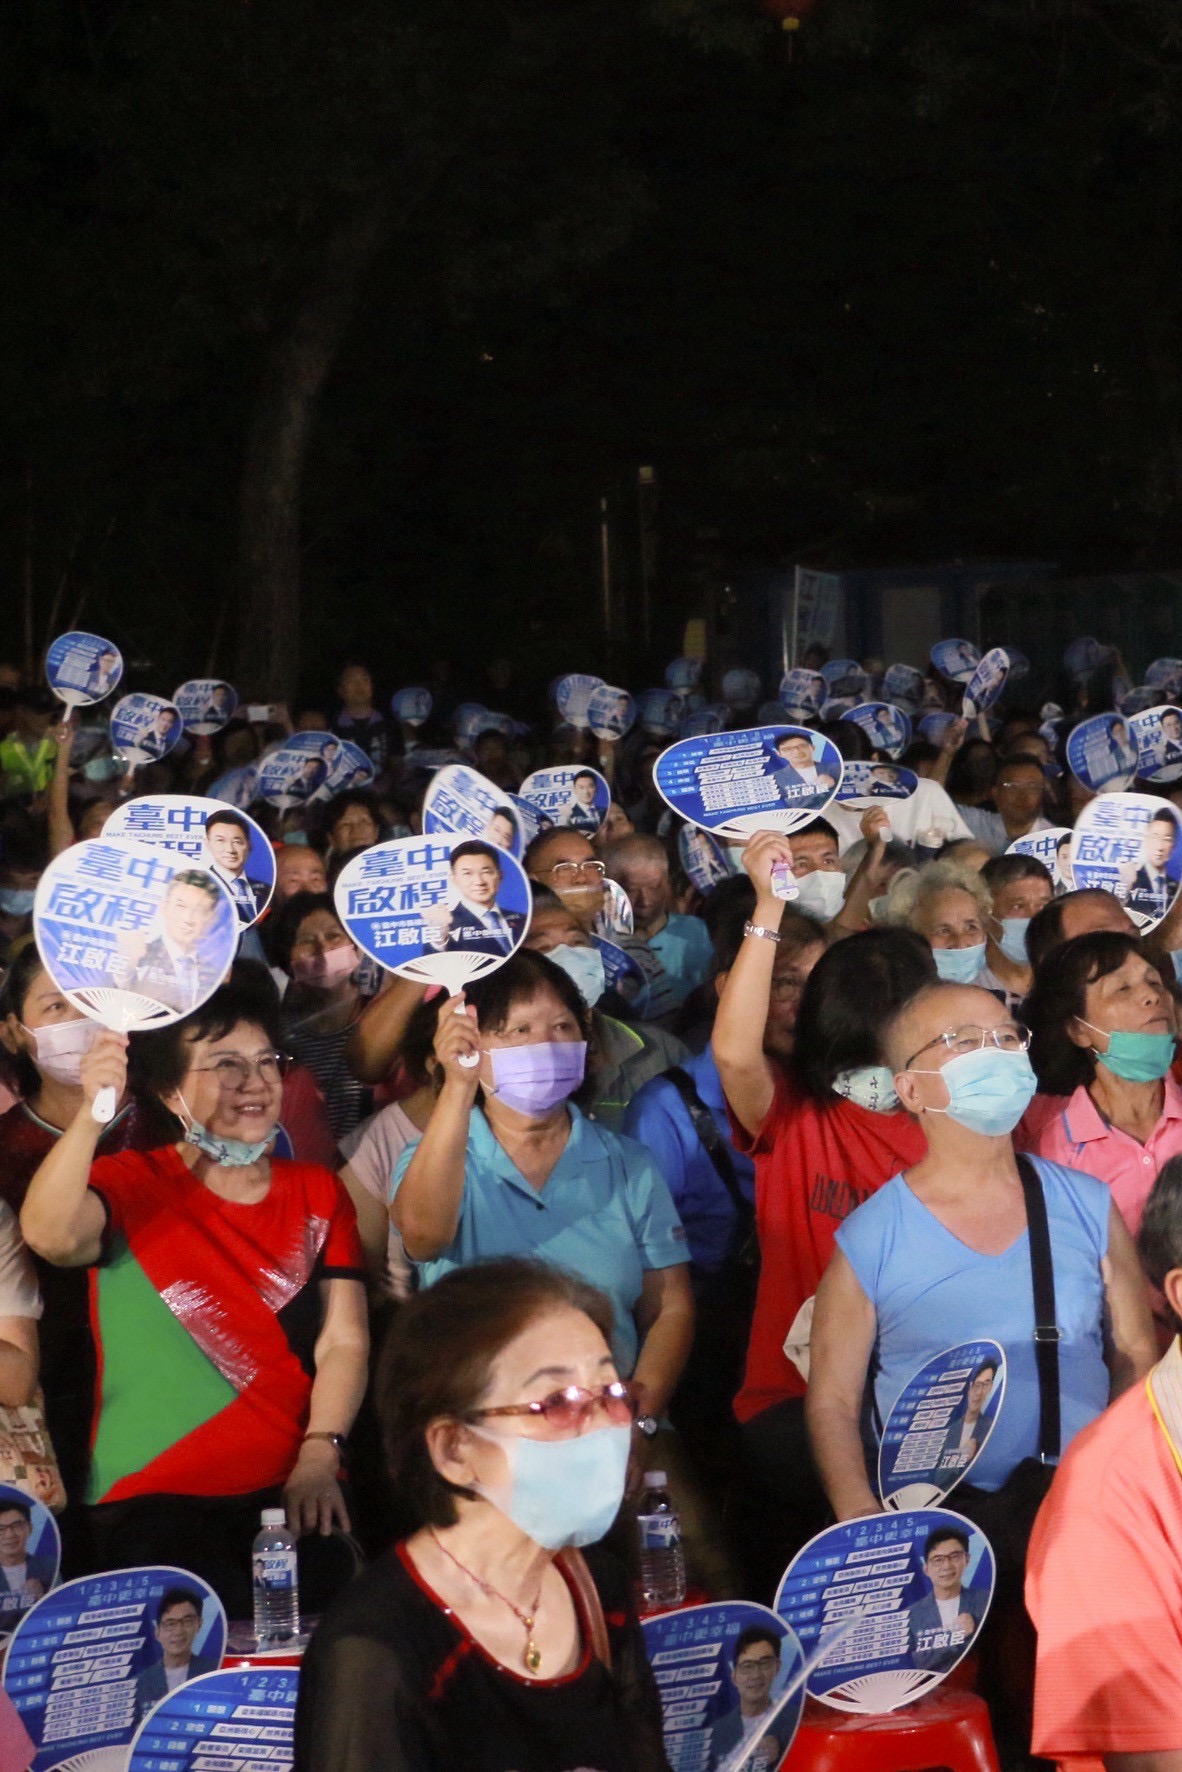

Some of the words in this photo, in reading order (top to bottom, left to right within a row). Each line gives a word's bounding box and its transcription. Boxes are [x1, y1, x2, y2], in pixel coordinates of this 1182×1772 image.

[450, 767, 501, 814] 臺中
[531, 771, 575, 790] 臺中
[787, 784, 830, 800] 江啟臣
[124, 803, 208, 832] 臺中
[1092, 801, 1155, 829] 臺中
[127, 831, 164, 839] TAICHUNG
[359, 843, 451, 880] 臺中
[1075, 834, 1143, 865] 啟程
[75, 842, 175, 889] 臺中
[44, 882, 160, 936] 啟程
[346, 881, 450, 915] 啟程
[373, 926, 444, 948] 江啟臣
[55, 941, 131, 976] 江啟臣
[855, 1525, 929, 1548] 臺中更幸福
[88, 1584, 164, 1608] 臺中更幸福
[664, 1622, 741, 1647] 臺中更幸福
[915, 1629, 966, 1653] 江啟臣
[258, 1677, 268, 1688] 2
[278, 1678, 288, 1688] 3
